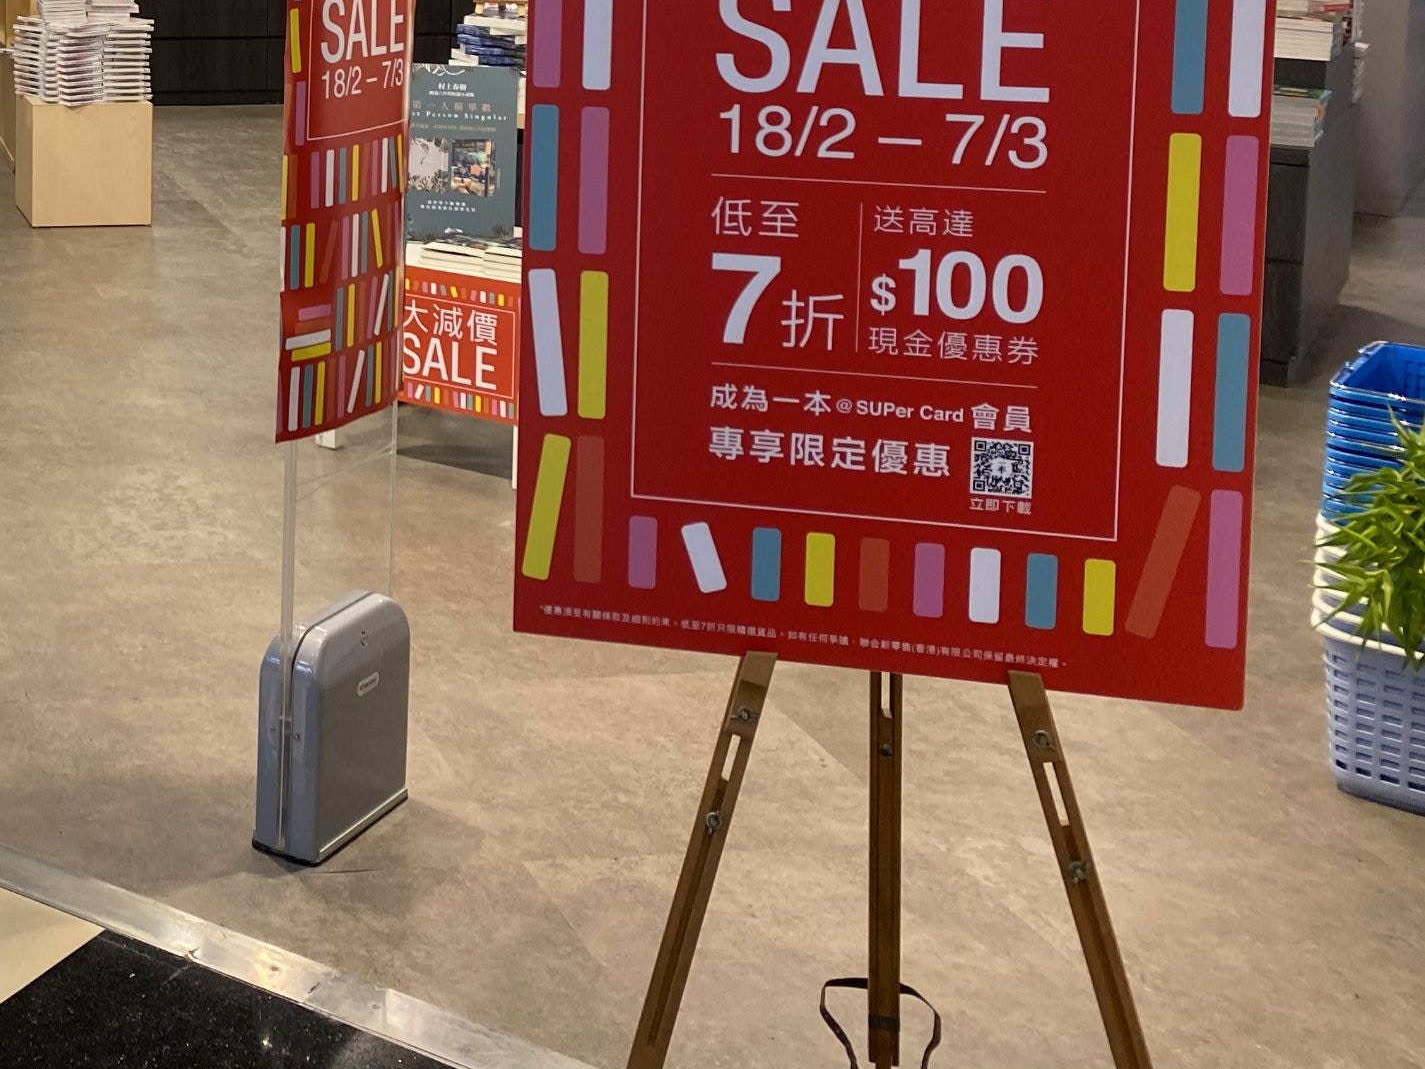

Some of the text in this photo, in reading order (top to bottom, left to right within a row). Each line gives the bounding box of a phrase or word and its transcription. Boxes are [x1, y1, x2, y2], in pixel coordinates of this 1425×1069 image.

[321, 66, 362, 99] 18/2
[381, 59, 404, 88] 7/3
[719, 104, 855, 159] 18/2
[945, 114, 1048, 169] 7/3
[711, 197, 799, 238] 低至
[873, 205, 973, 238] 送高達
[870, 248, 1044, 323] $100
[403, 299, 498, 346] 大減價
[868, 326, 1039, 364] 現金優惠券
[403, 332, 498, 390] SALE
[710, 382, 832, 416] 成為一本
[857, 400, 914, 418] SUPer
[920, 405, 964, 423] Card
[970, 403, 1032, 433] 會員
[708, 426, 950, 477] 專享限定優惠
[970, 497, 1032, 515] 立即下載
